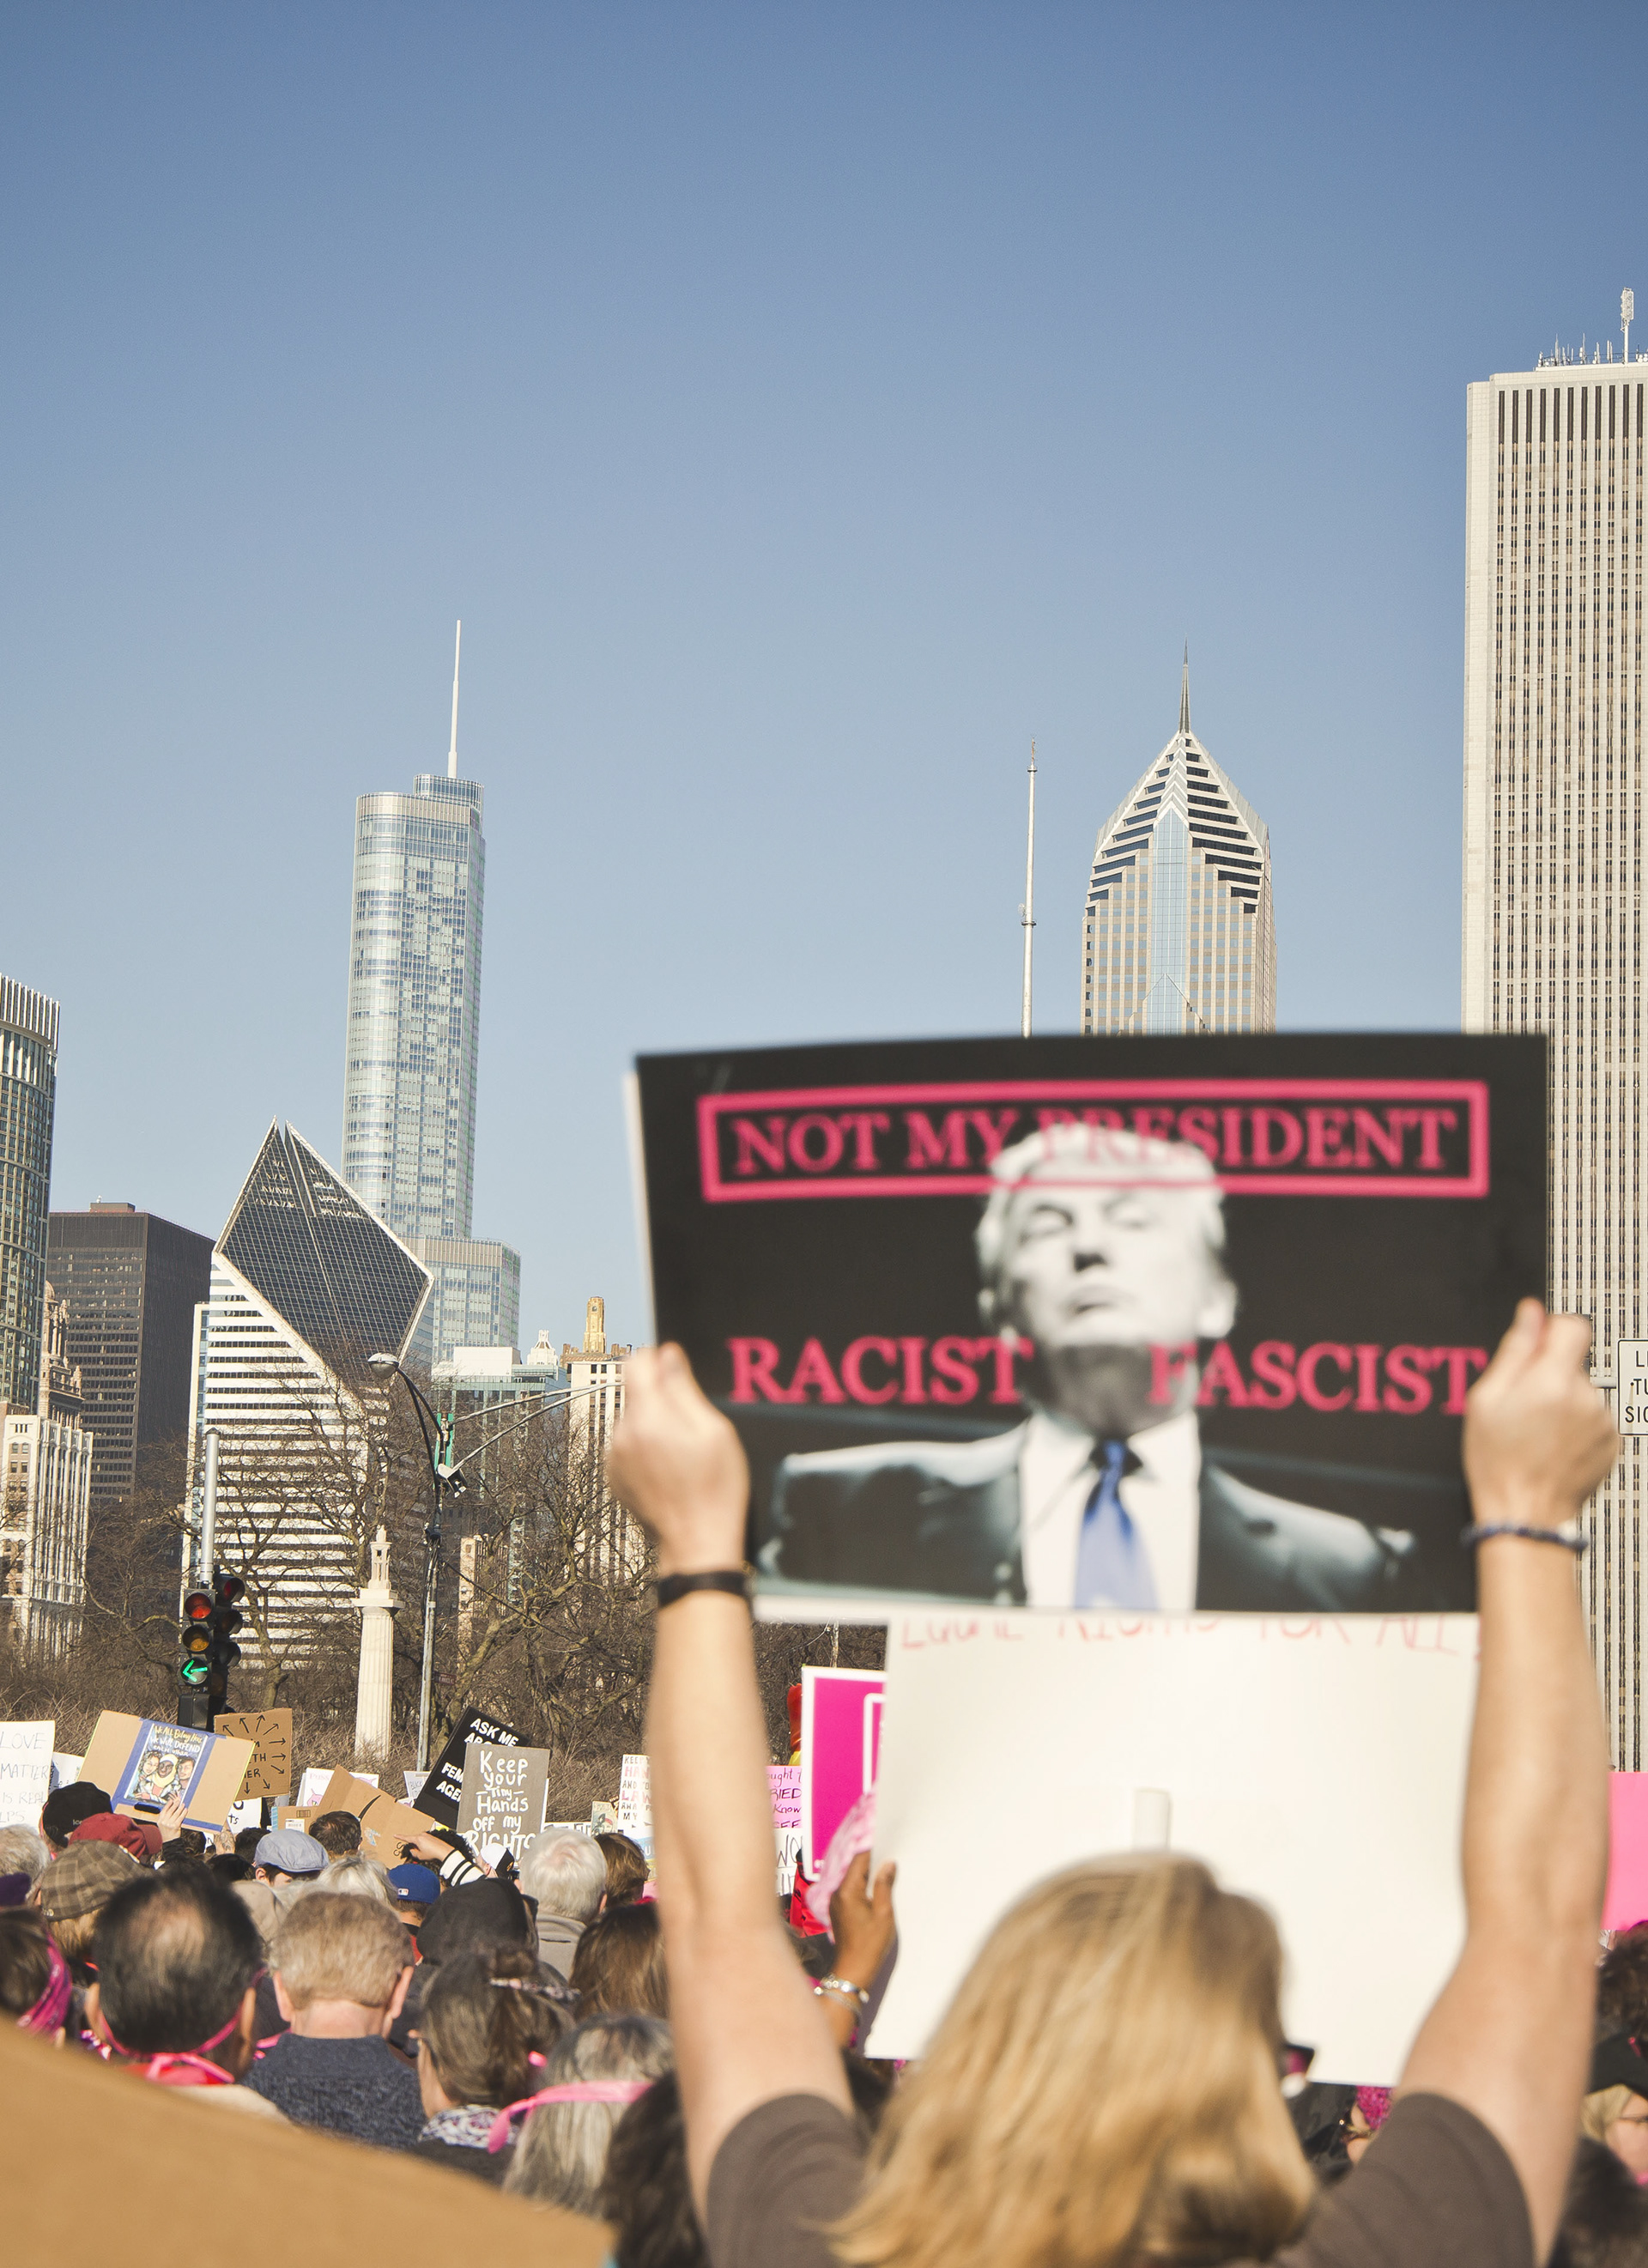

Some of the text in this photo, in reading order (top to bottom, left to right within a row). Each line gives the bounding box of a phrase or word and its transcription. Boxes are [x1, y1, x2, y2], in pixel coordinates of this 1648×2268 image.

[733, 1106, 1458, 1175] NOT MY PRESIDENT
[1635, 1350, 1648, 1367] L
[726, 1337, 1490, 1418] RACIST FASCIST
[0, 1731, 46, 1750] LOVE
[470, 1718, 519, 1747] ASK ME
[480, 1750, 529, 1775] Keep
[483, 1772, 528, 1790] your
[488, 1787, 512, 1802] Tiny
[477, 1795, 530, 1815] Hands
